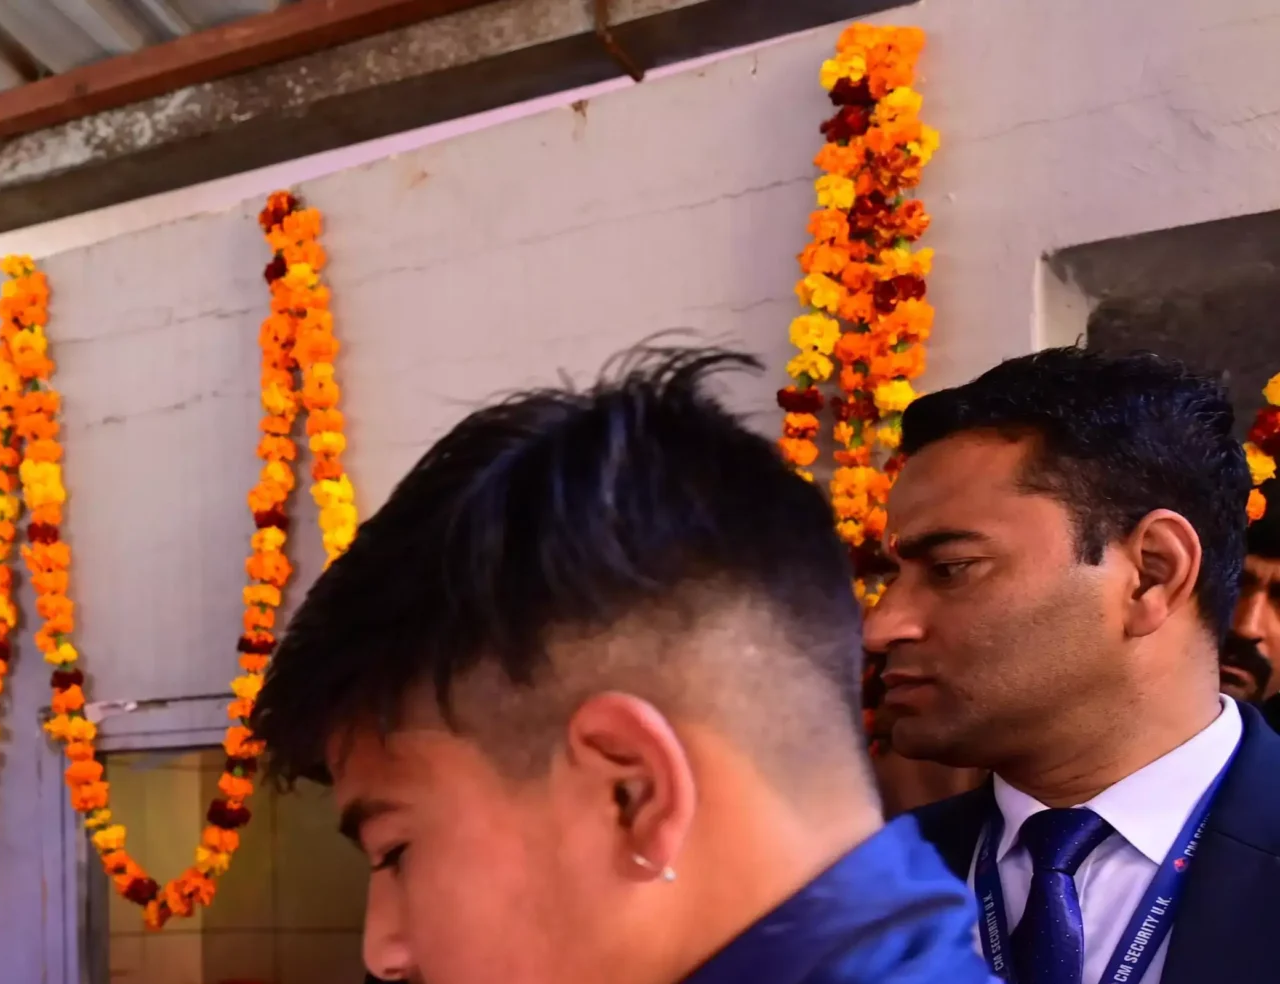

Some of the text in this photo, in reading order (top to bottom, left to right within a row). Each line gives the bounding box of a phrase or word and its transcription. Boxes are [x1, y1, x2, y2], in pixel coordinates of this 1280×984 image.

[1151, 896, 1173, 916] U.K.
[985, 910, 1001, 954] SECURITY
[1123, 915, 1160, 964] SECURITY
[1114, 965, 1135, 983] CM
